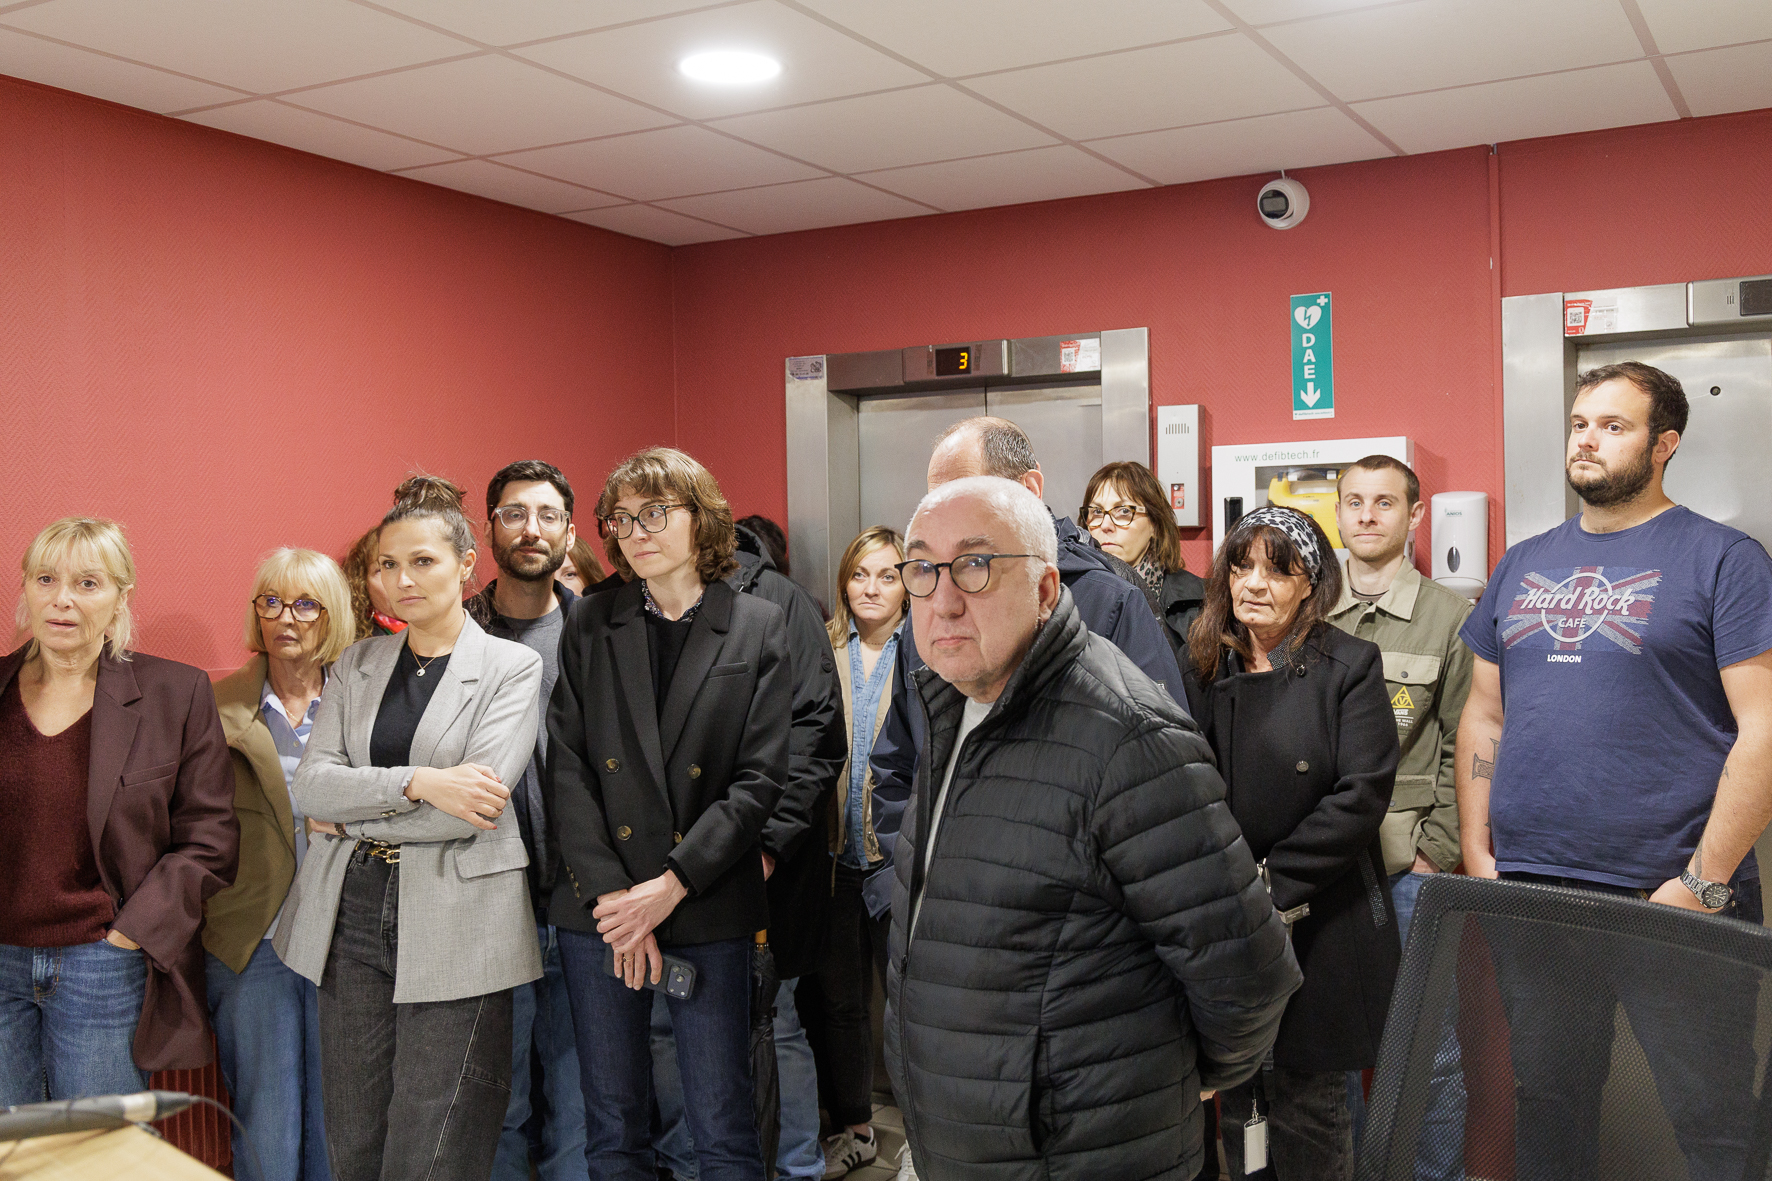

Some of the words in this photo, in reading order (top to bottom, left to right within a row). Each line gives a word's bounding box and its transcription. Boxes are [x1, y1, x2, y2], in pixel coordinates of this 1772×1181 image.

[958, 352, 969, 370] 3
[1301, 332, 1317, 379] DAE
[1234, 449, 1320, 463] www.defibtech.fr
[1520, 586, 1582, 610] Hard
[1577, 586, 1636, 616] Rock
[1558, 618, 1587, 628] CAFE
[1546, 654, 1582, 663] LONDON
